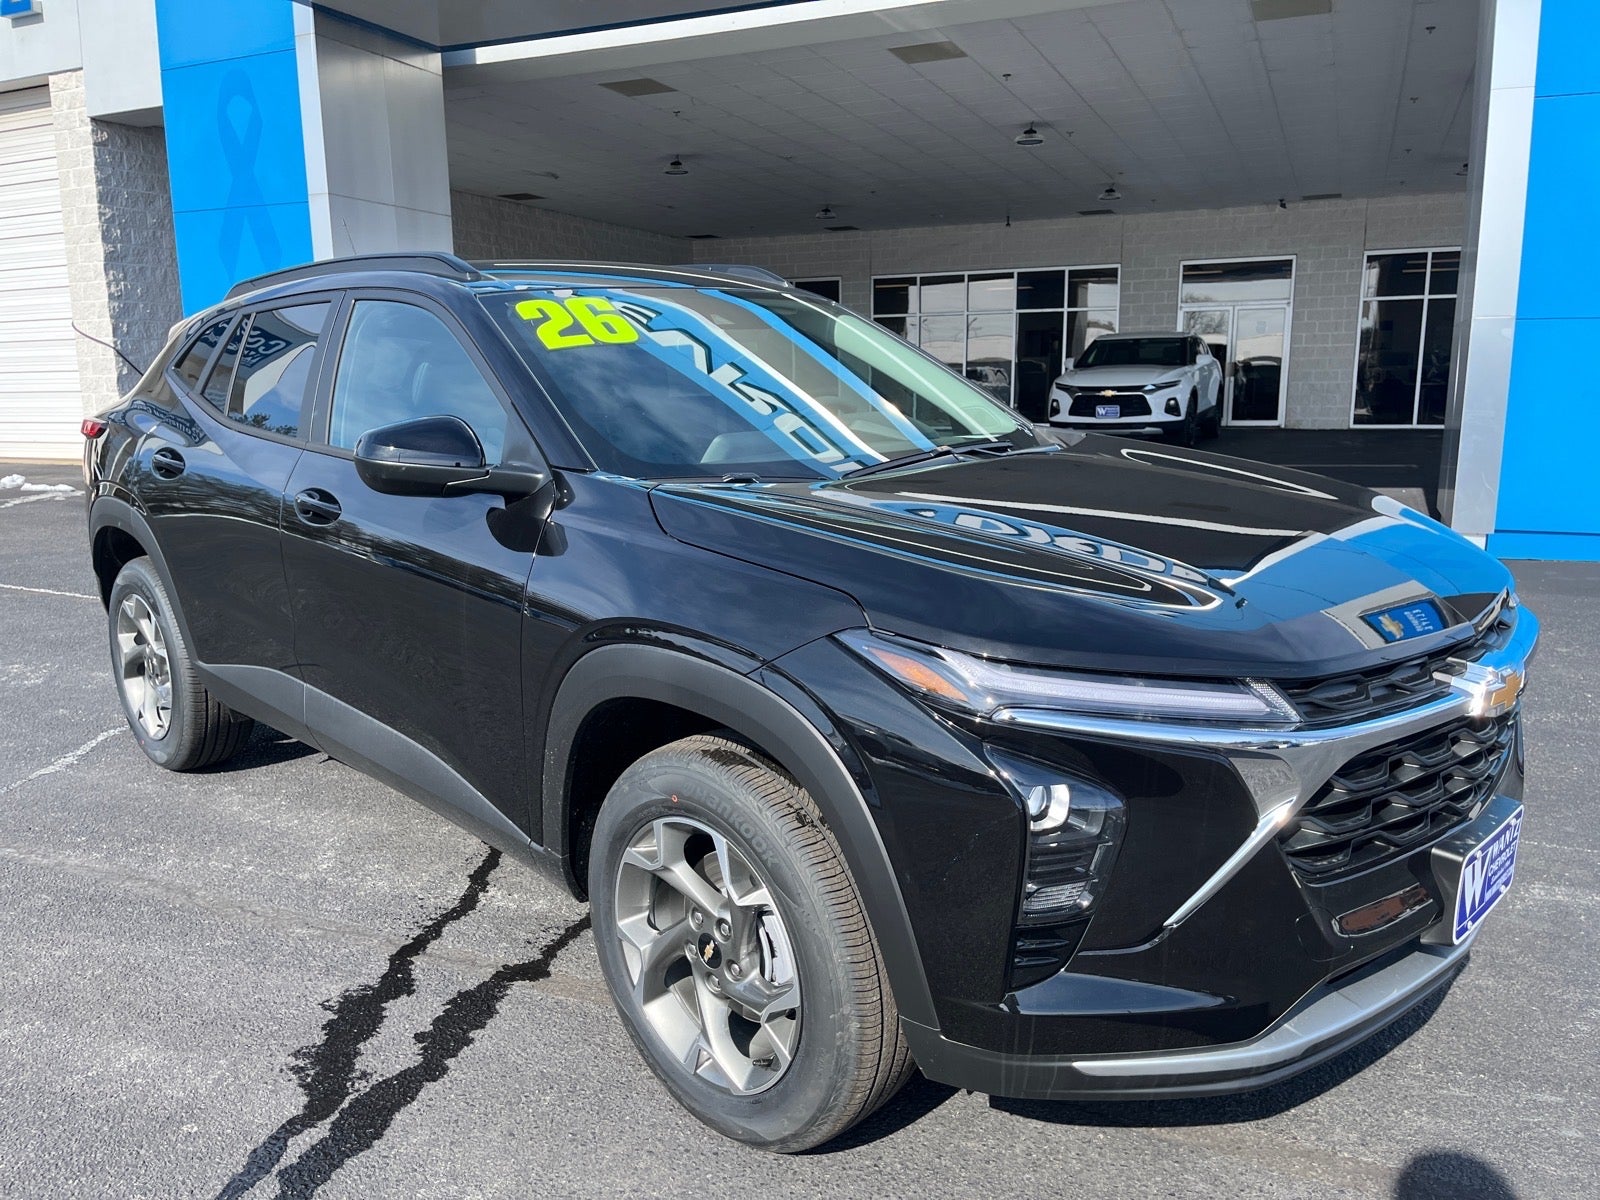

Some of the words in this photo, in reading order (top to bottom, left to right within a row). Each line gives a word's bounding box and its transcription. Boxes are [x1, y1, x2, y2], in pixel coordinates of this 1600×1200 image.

[515, 297, 639, 350] 26
[1464, 848, 1493, 919] W
[1488, 843, 1517, 877] CHEVROLET
